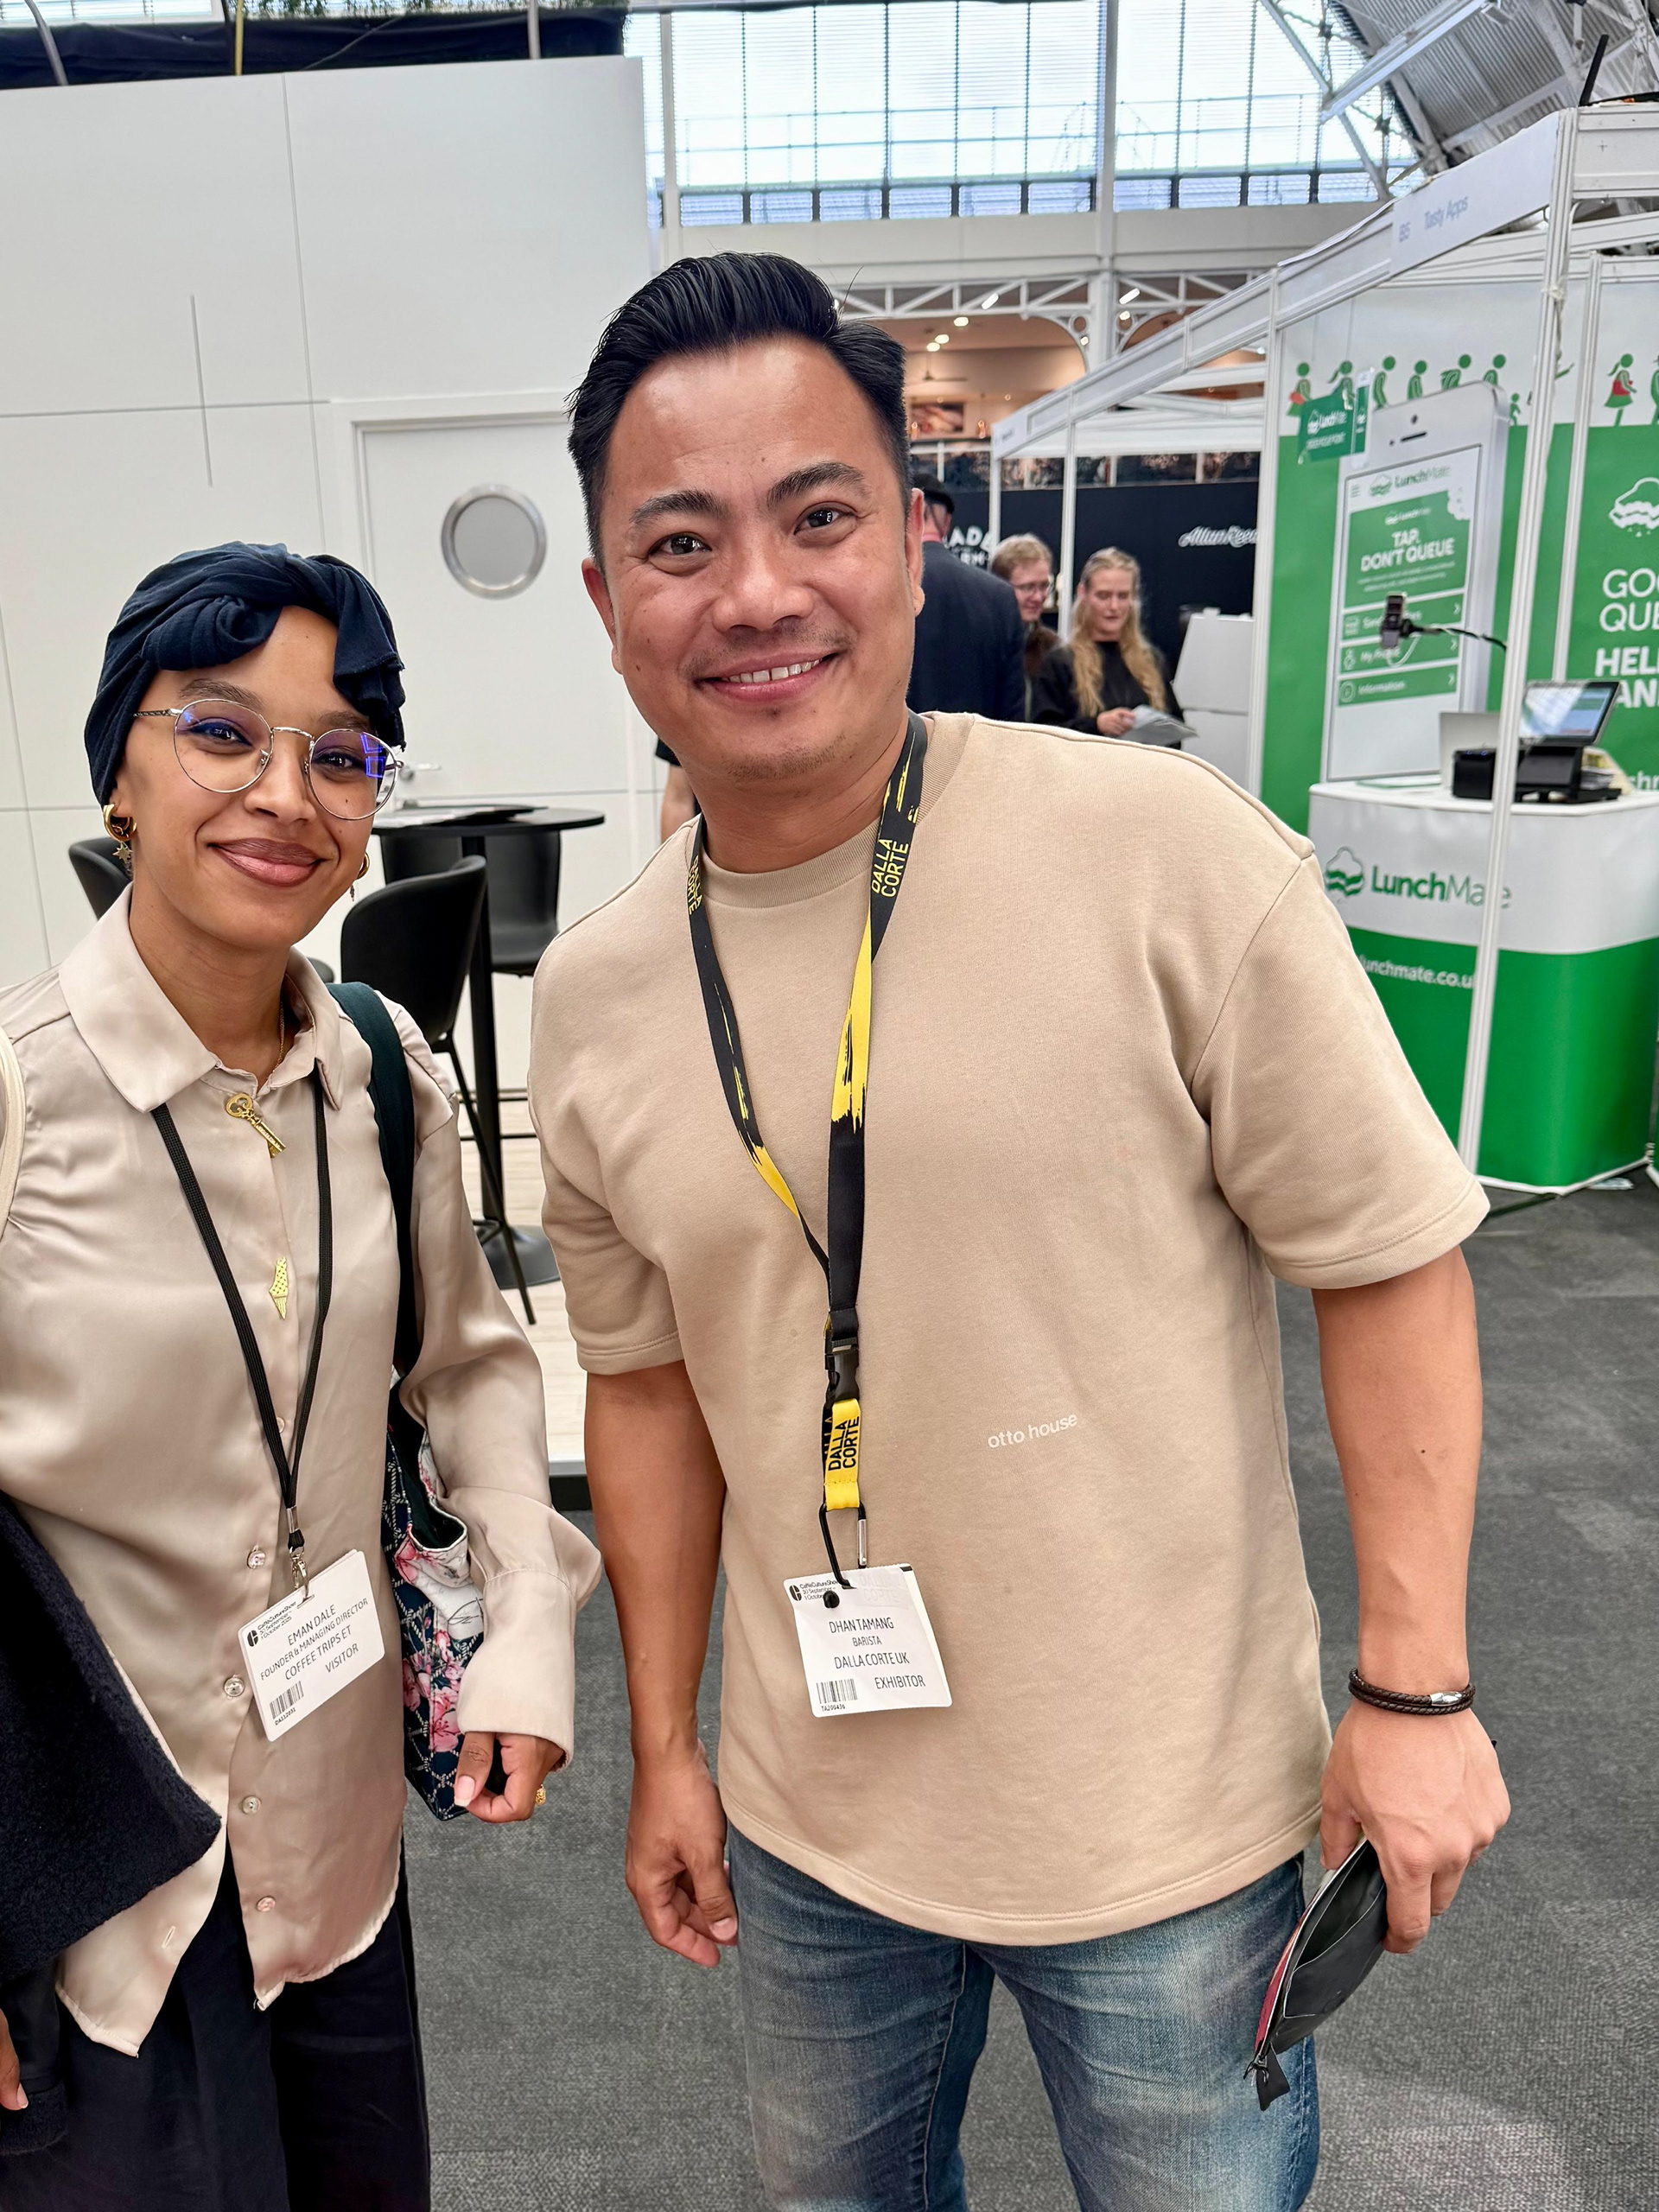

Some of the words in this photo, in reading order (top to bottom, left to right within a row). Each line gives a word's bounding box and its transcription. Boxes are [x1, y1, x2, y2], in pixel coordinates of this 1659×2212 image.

[1424, 207, 1446, 230] Tasty
[1445, 196, 1469, 222] Apps
[1405, 537, 1455, 563] QUEUE
[1603, 568, 1659, 599] GO
[1594, 646, 1659, 677] HEL
[1615, 678, 1659, 709] AN
[871, 839, 893, 894] DALLA
[880, 841, 909, 898] CORTE
[828, 1420, 848, 1471] DALLA
[842, 1415, 860, 1469] CORTE
[987, 1430, 1026, 1449] otto
[1027, 1414, 1078, 1440] house
[260, 1650, 295, 1681] FOUNDER
[293, 1647, 300, 1656] &
[299, 1620, 335, 1652] MANAGING
[334, 1598, 369, 1625] DIRECTOR
[288, 1621, 314, 1645] EMAN
[313, 1604, 336, 1627] DALE
[829, 1618, 856, 1633] DHAN
[855, 1617, 894, 1631] TAMANG
[284, 1649, 317, 1681] COFFEE
[316, 1632, 342, 1656] TRIPS
[340, 1624, 353, 1640] ET
[852, 1636, 882, 1647] BARISTA
[325, 1643, 359, 1674] VISITOR
[834, 1654, 865, 1669] DALLA
[865, 1652, 895, 1666] CORTE
[894, 1651, 910, 1664] UK
[874, 1675, 925, 1689] EXHIBITOR
